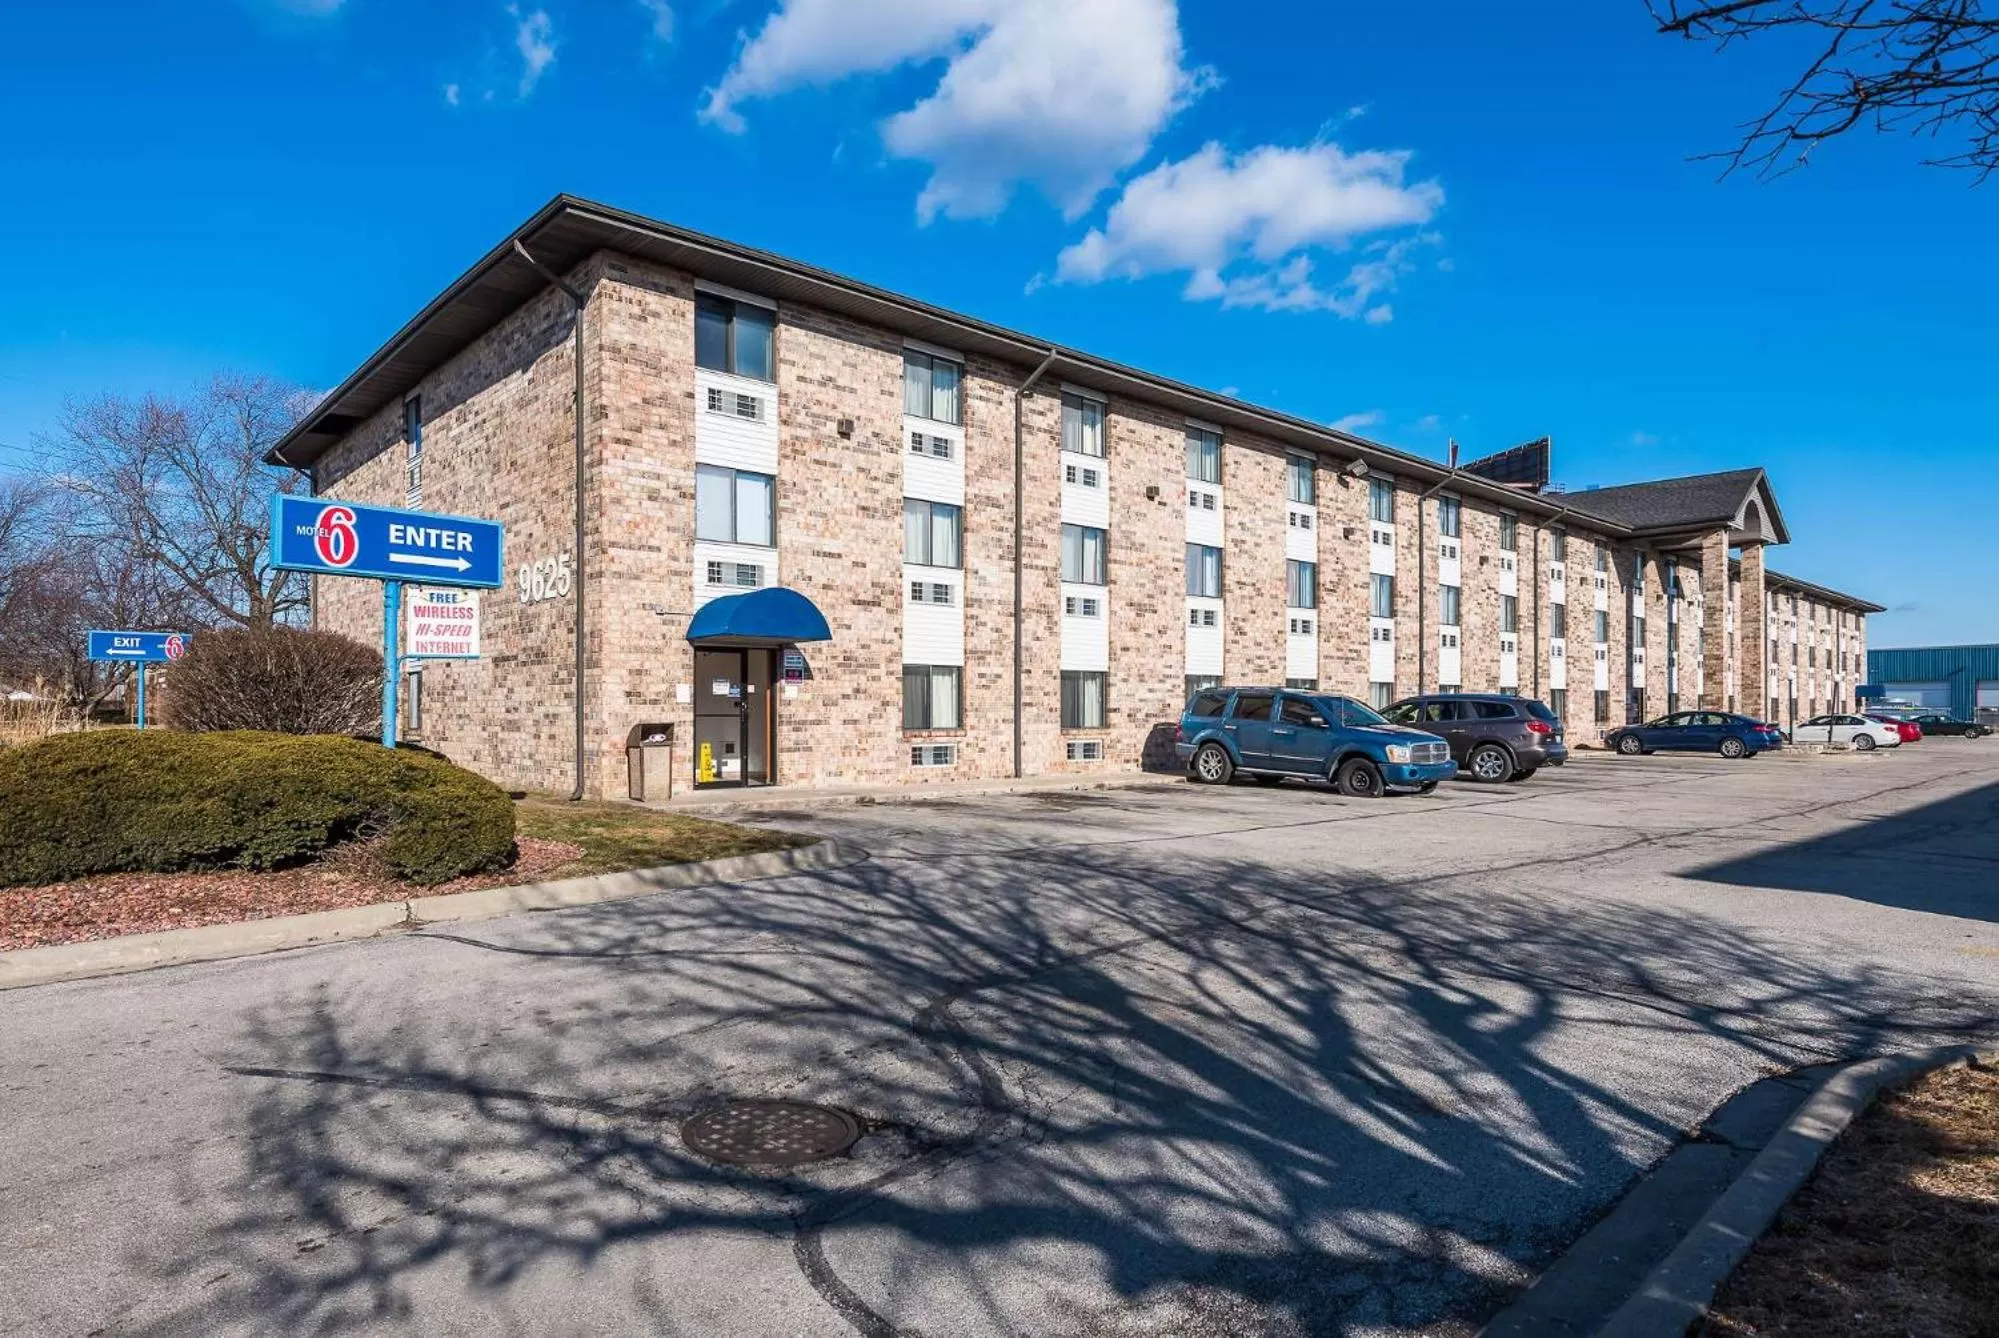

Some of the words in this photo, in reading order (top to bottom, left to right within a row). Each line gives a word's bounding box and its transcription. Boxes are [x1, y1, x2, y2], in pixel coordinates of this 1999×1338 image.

[296, 525, 331, 538] MOTEL
[314, 505, 359, 568] 6
[389, 524, 473, 552] ENTER
[519, 553, 571, 603] 9625
[429, 592, 458, 604] FREE
[414, 605, 474, 620] WIRELESS
[416, 623, 473, 637] HI-SPEED
[114, 637, 141, 647] EXIT
[165, 634, 185, 660] 6
[416, 640, 473, 654] INTERNET
